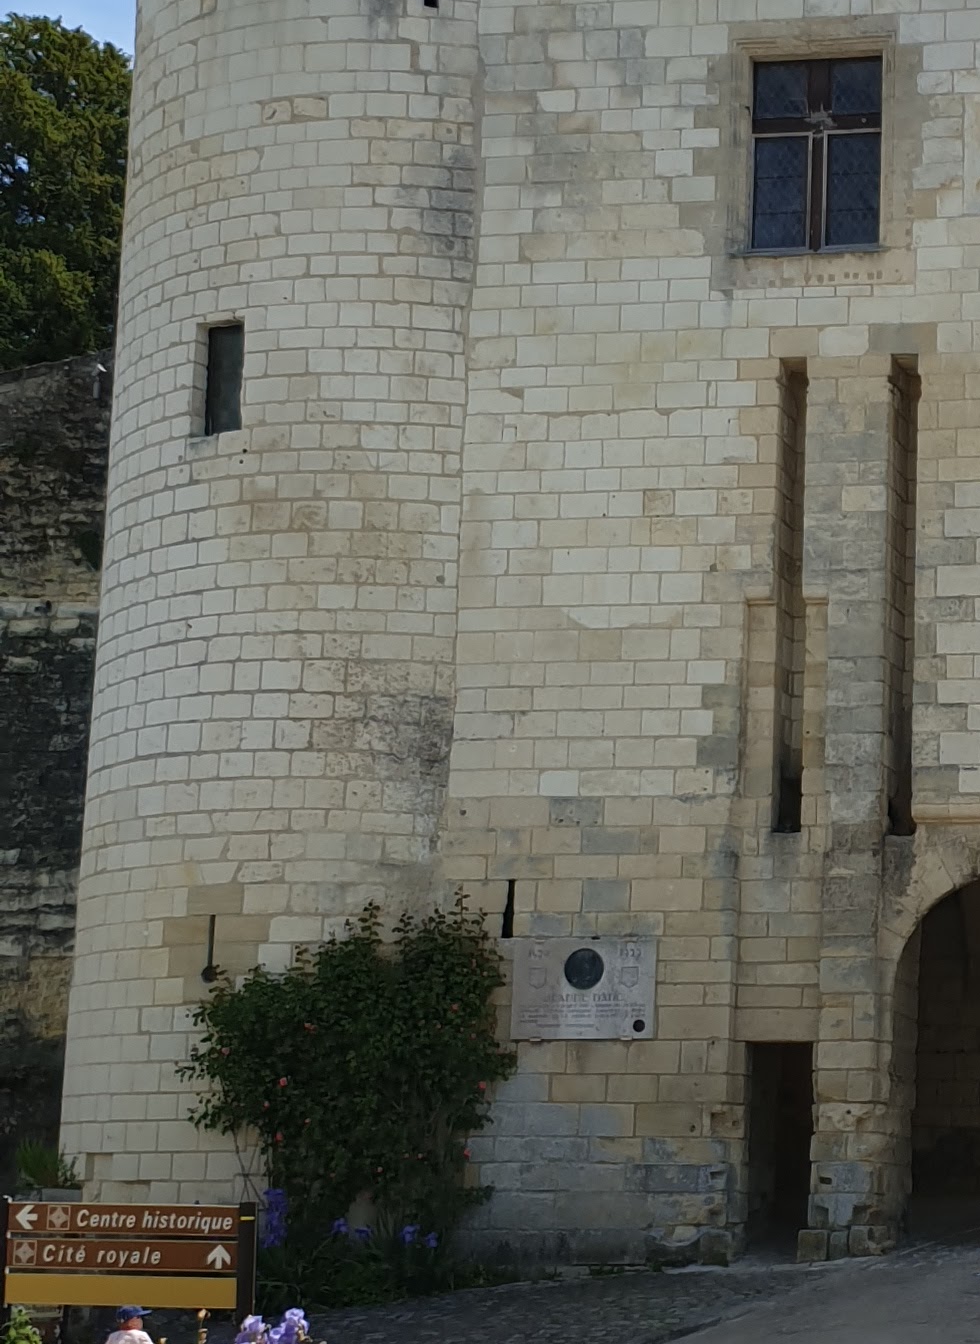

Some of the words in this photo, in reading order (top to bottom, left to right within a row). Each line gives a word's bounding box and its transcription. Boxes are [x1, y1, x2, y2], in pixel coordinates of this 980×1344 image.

[76, 1209, 136, 1229] Centre
[141, 1211, 233, 1234] historique
[43, 1244, 85, 1263] Cité
[96, 1246, 161, 1267] royale
